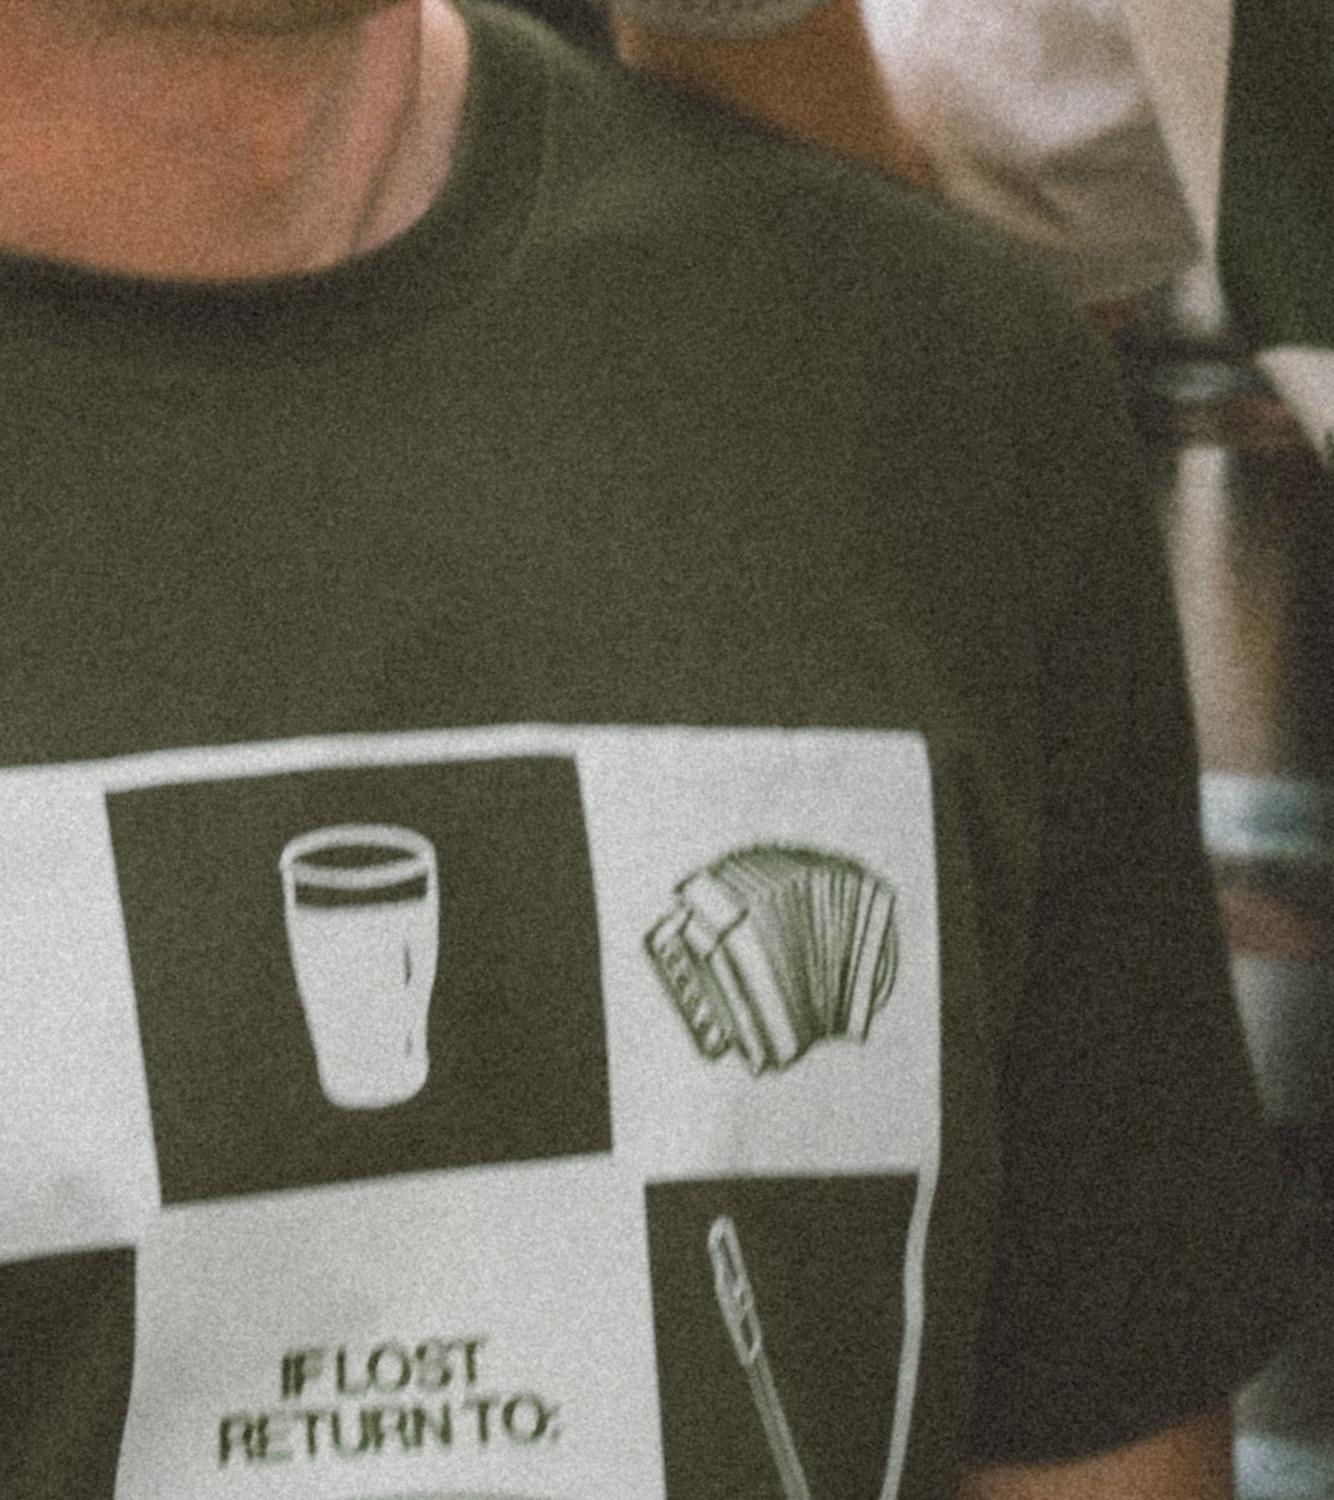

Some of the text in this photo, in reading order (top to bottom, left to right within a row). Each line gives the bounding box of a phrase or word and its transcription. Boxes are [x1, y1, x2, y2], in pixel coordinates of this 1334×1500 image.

[279, 1336, 488, 1400] IF LOST
[217, 1404, 452, 1466] RETURN
